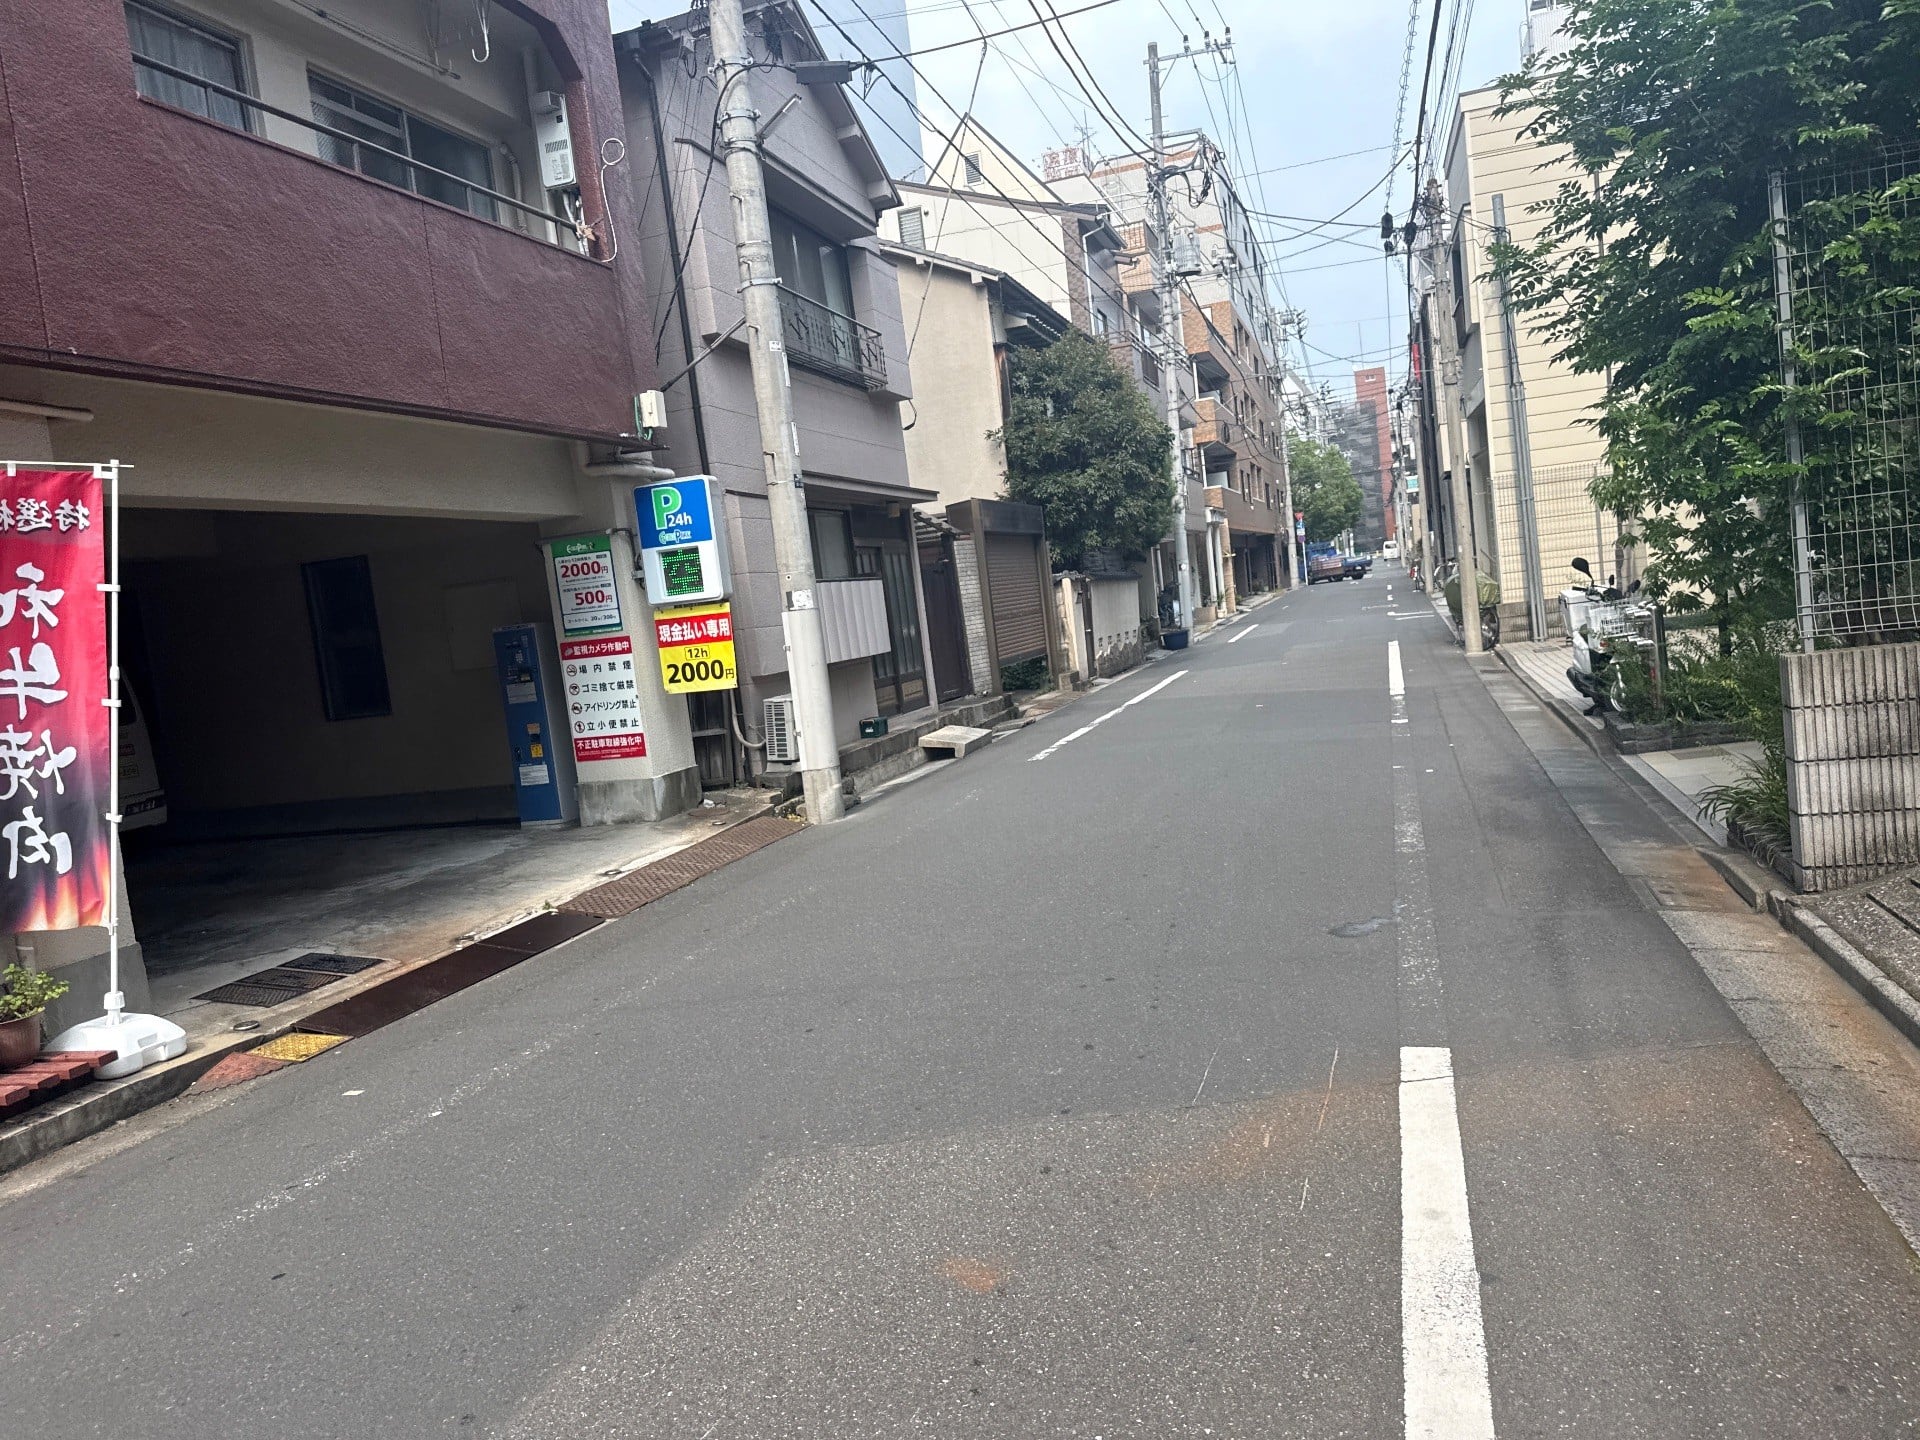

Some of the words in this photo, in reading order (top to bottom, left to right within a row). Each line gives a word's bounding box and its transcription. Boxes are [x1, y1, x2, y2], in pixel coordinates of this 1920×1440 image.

[651, 487, 682, 530] P
[667, 512, 693, 528] 24h
[661, 549, 704, 597] 空
[658, 618, 730, 642] 現金払い専用
[573, 641, 630, 656] 監視カメラ作動中
[687, 647, 708, 659] 12h
[579, 660, 632, 674] 場内禁煙
[581, 679, 635, 693] ゴミ捨て厳禁
[583, 699, 637, 713] アイドリング禁止
[587, 718, 640, 731] 立小便禁止
[576, 736, 643, 750] 不正駐車取締強化中
